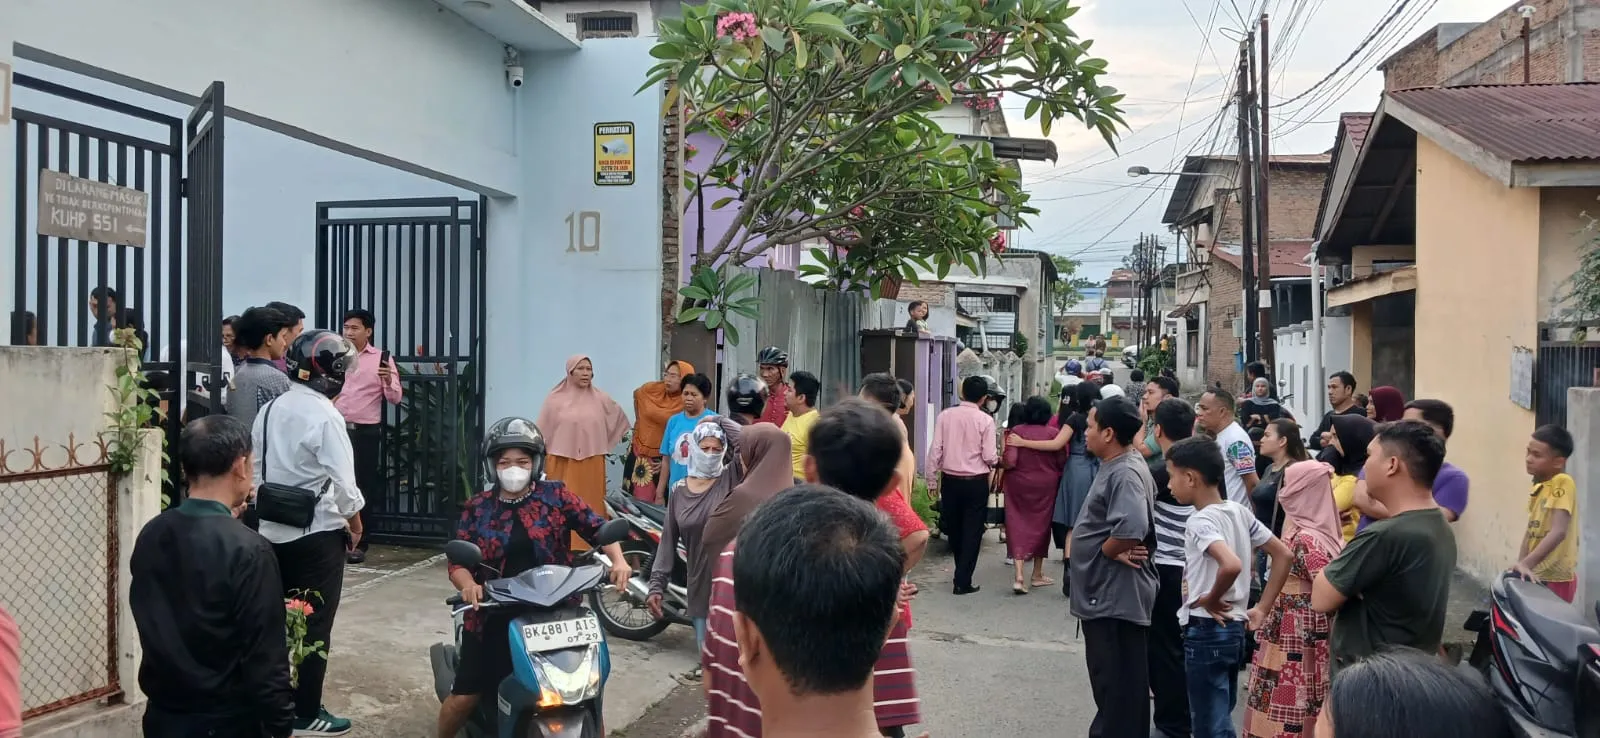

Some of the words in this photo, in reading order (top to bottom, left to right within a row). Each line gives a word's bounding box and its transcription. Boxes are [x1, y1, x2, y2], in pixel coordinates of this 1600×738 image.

[51, 206, 87, 229] KUHP
[564, 211, 600, 252] 10
[525, 627, 540, 639] BK
[541, 622, 569, 635] 4881
[575, 618, 597, 631] AIS
